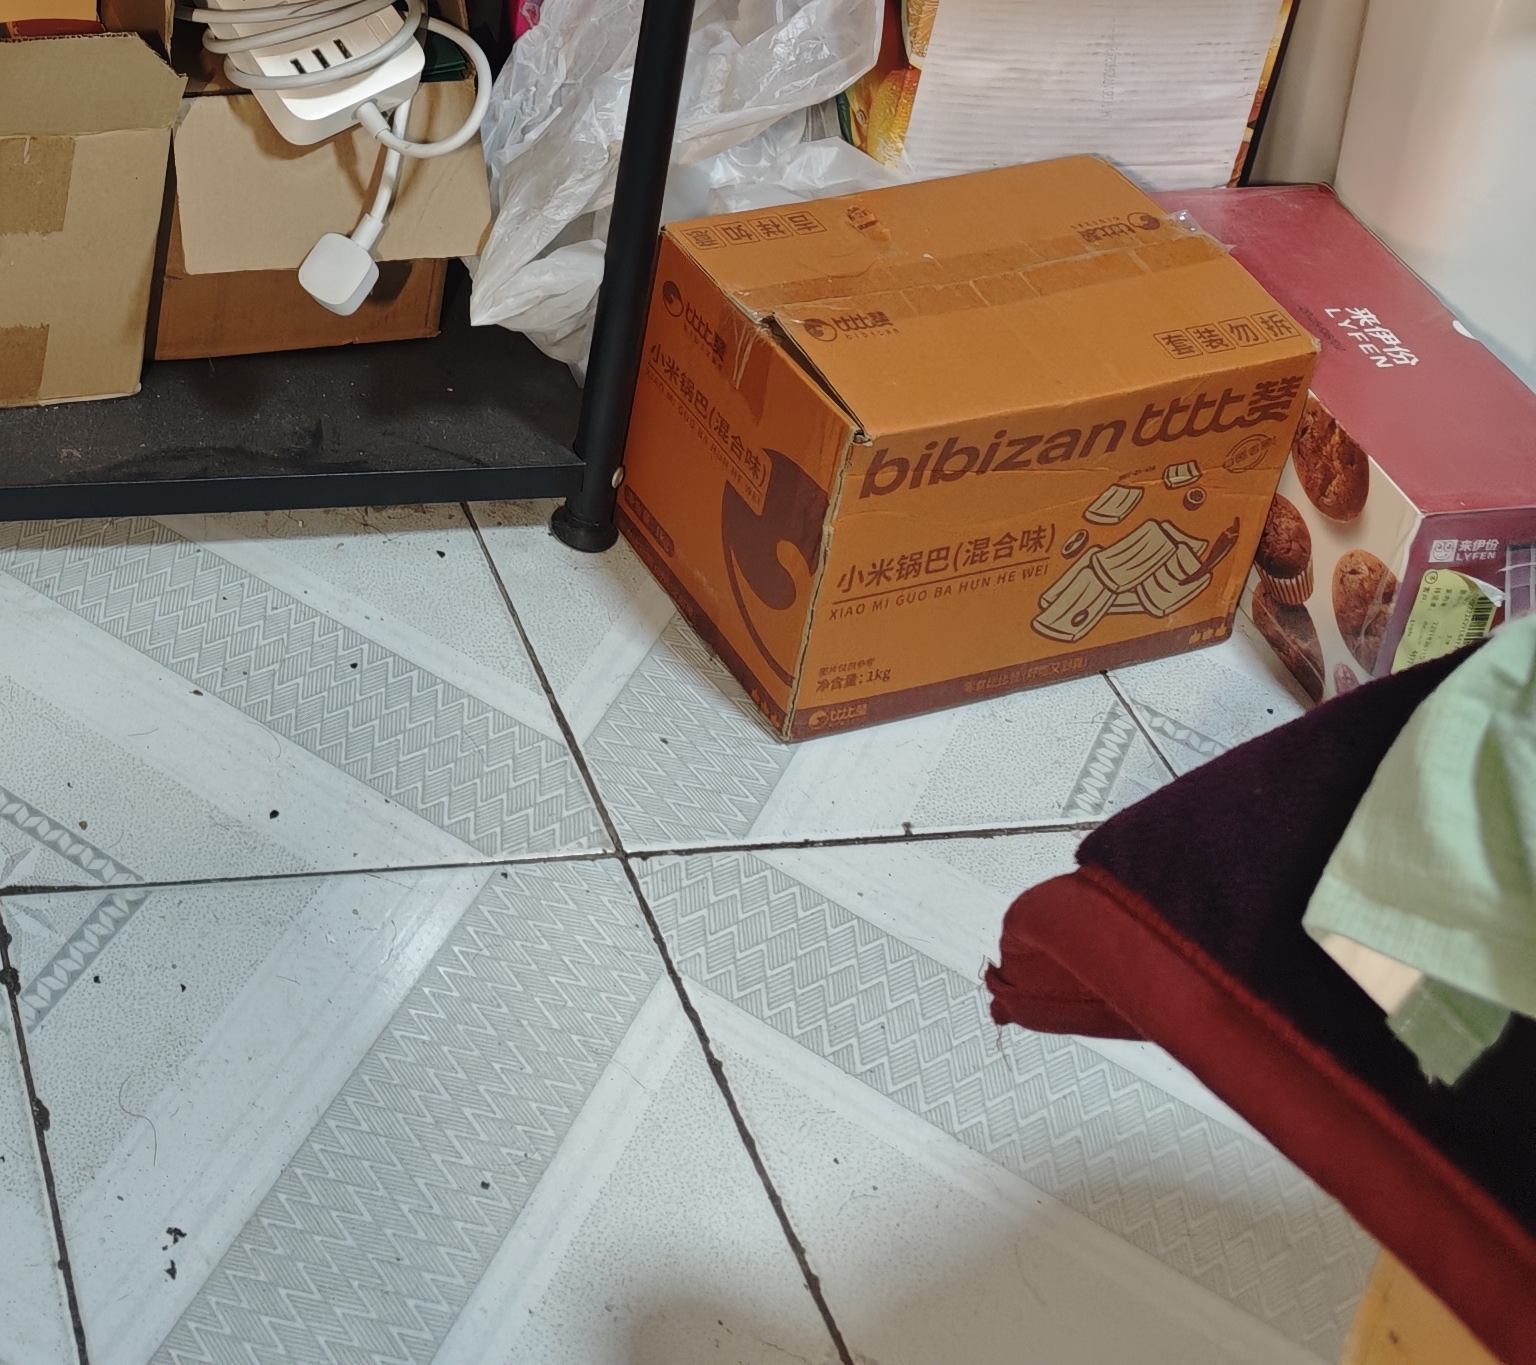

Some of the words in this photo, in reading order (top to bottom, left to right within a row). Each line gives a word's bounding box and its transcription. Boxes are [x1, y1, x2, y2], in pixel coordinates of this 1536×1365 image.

[1154, 310, 1298, 361] 套装勿拆
[1324, 307, 1394, 370] LYFEN
[1344, 306, 1419, 368] 来伊份
[649, 339, 769, 499] 小米锅巴(混合味)
[860, 417, 1127, 499] bibizan
[835, 525, 1057, 594] 小米锅巴(混合味)
[1455, 552, 1496, 562] LYFEN
[1459, 539, 1500, 552] 来伊份
[829, 600, 866, 621] XIAO
[872, 597, 890, 613] MI
[896, 590, 929, 609] GUO
[934, 586, 955, 602] BA
[960, 578, 992, 597] HUN
[997, 574, 1017, 590] HE
[1020, 564, 1050, 584] WEI
[816, 667, 893, 695] 净含量:1kg
